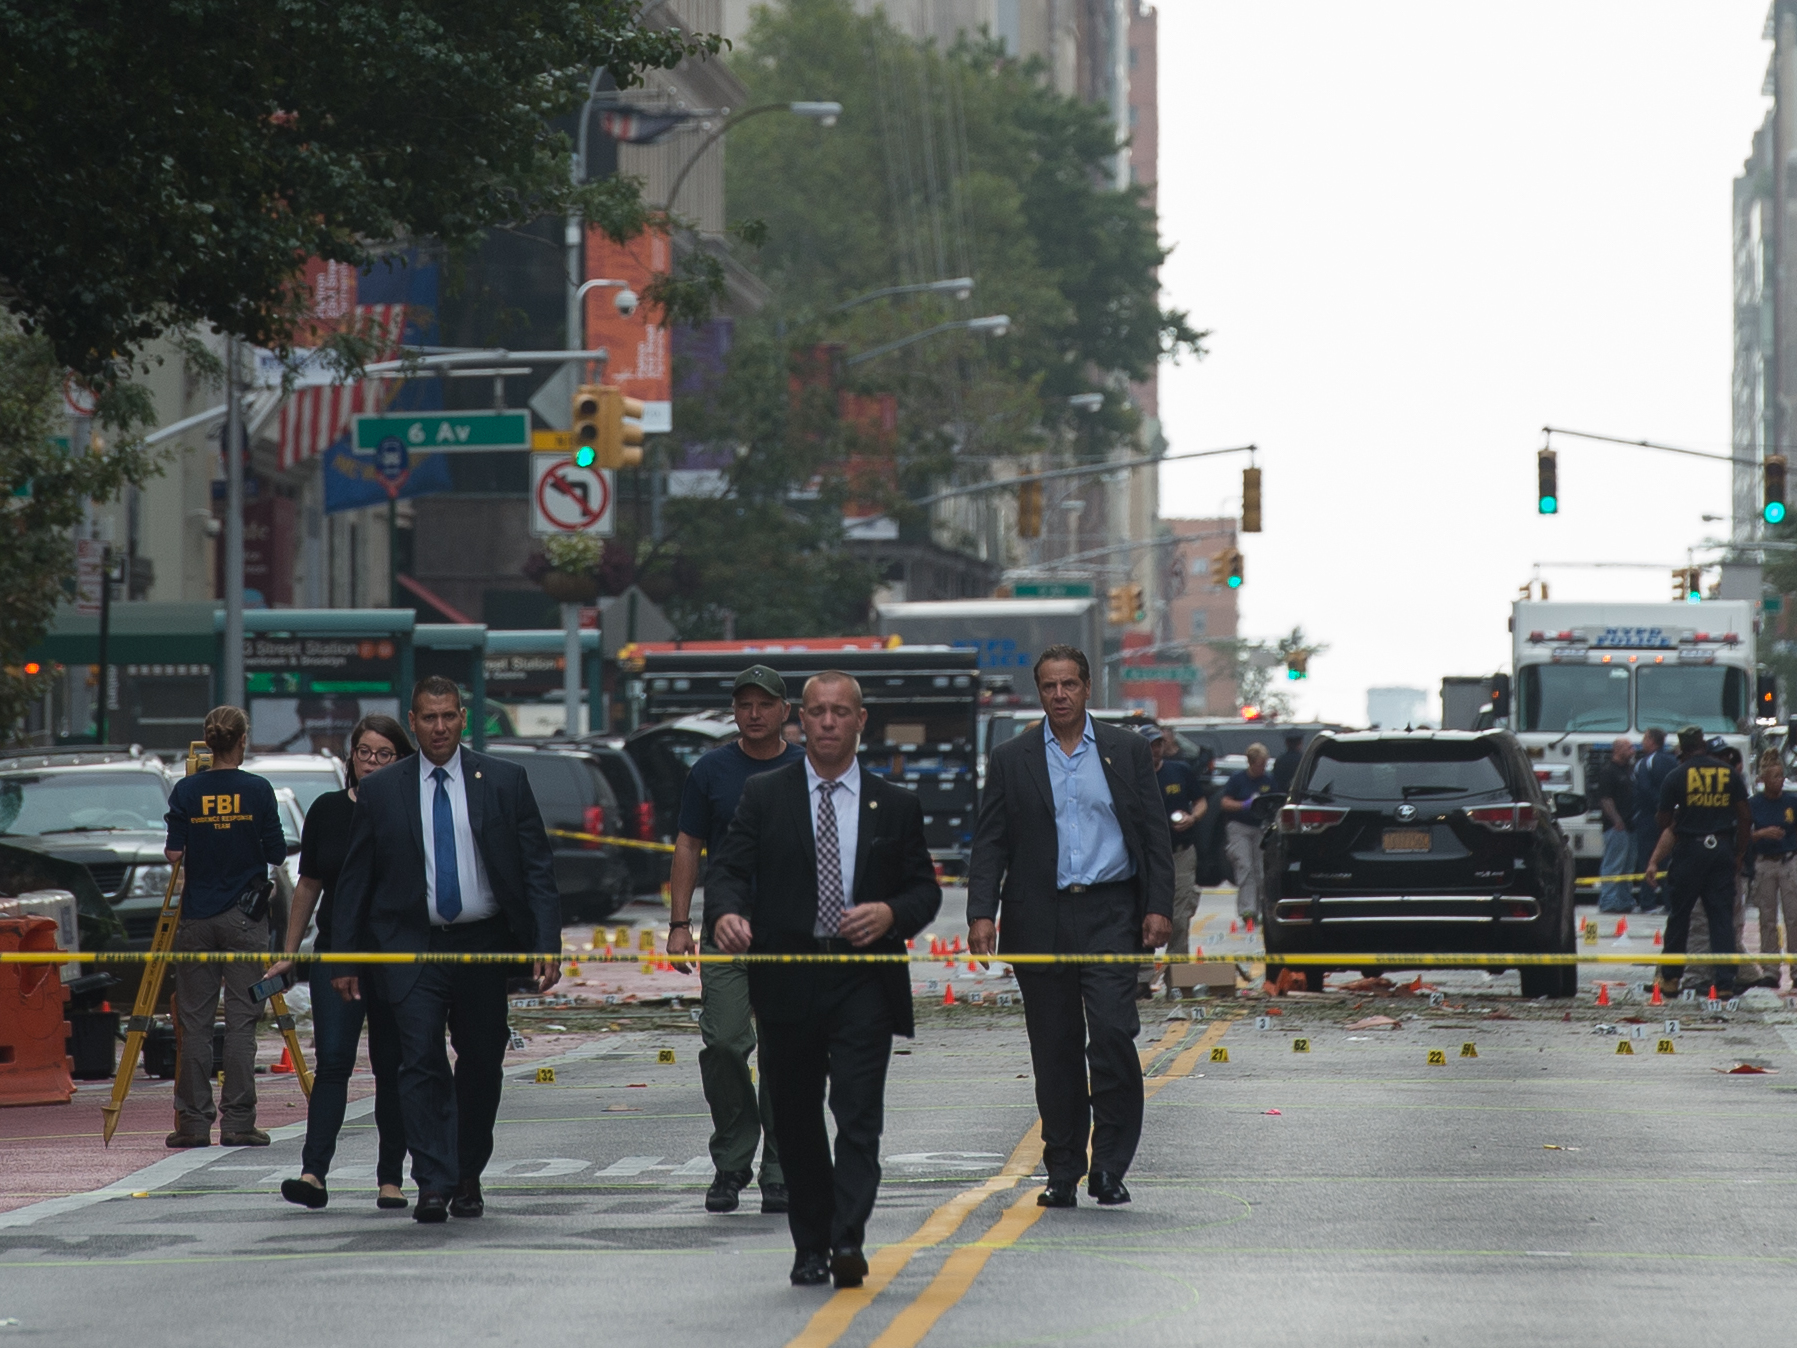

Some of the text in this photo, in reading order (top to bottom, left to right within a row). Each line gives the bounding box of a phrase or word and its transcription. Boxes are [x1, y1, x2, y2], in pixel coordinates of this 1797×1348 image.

[407, 421, 471, 444] 6 Av
[255, 640, 302, 656] Street
[304, 639, 358, 656] Station
[1686, 766, 1731, 793] ATF
[202, 793, 241, 815] FBI
[1686, 793, 1731, 807] POLICE
[659, 1050, 672, 1062] 60
[1211, 1049, 1224, 1061] 21
[1429, 1051, 1442, 1063] 22
[541, 1069, 554, 1082] 32
